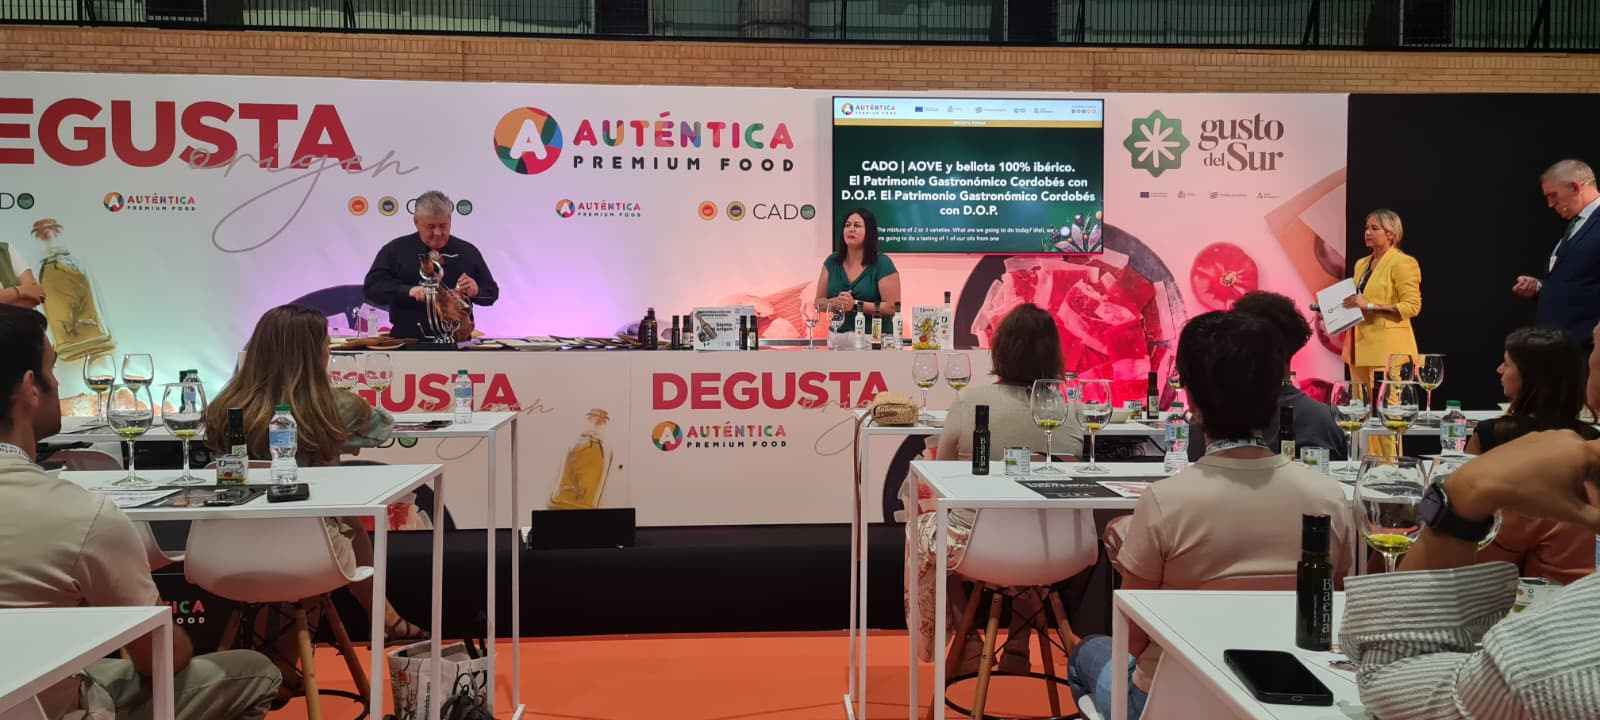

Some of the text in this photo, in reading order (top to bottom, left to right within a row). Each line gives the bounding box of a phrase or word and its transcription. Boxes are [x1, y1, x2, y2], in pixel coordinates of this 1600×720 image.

[573, 111, 795, 150] AUTÉNTICA
[1197, 113, 1284, 151] gusto
[573, 156, 795, 172] PREMIUM FOOD
[1203, 141, 1285, 172] del Sur
[861, 161, 898, 172] CADO
[907, 161, 943, 172] AOVE
[946, 164, 953, 175] y
[956, 161, 996, 172] bellota
[999, 162, 1031, 173] 100%
[1033, 161, 1076, 173] ibérico.
[849, 176, 1088, 188] El Patrimonio Gastronómico Cordobés con
[841, 190, 1096, 202] D.O.P. El Patrimonio Gastronómico Cordobés
[939, 205, 998, 216] con D.O.P.
[652, 371, 889, 410] DEGUSTA
[686, 421, 786, 438] AUTÉNTICA
